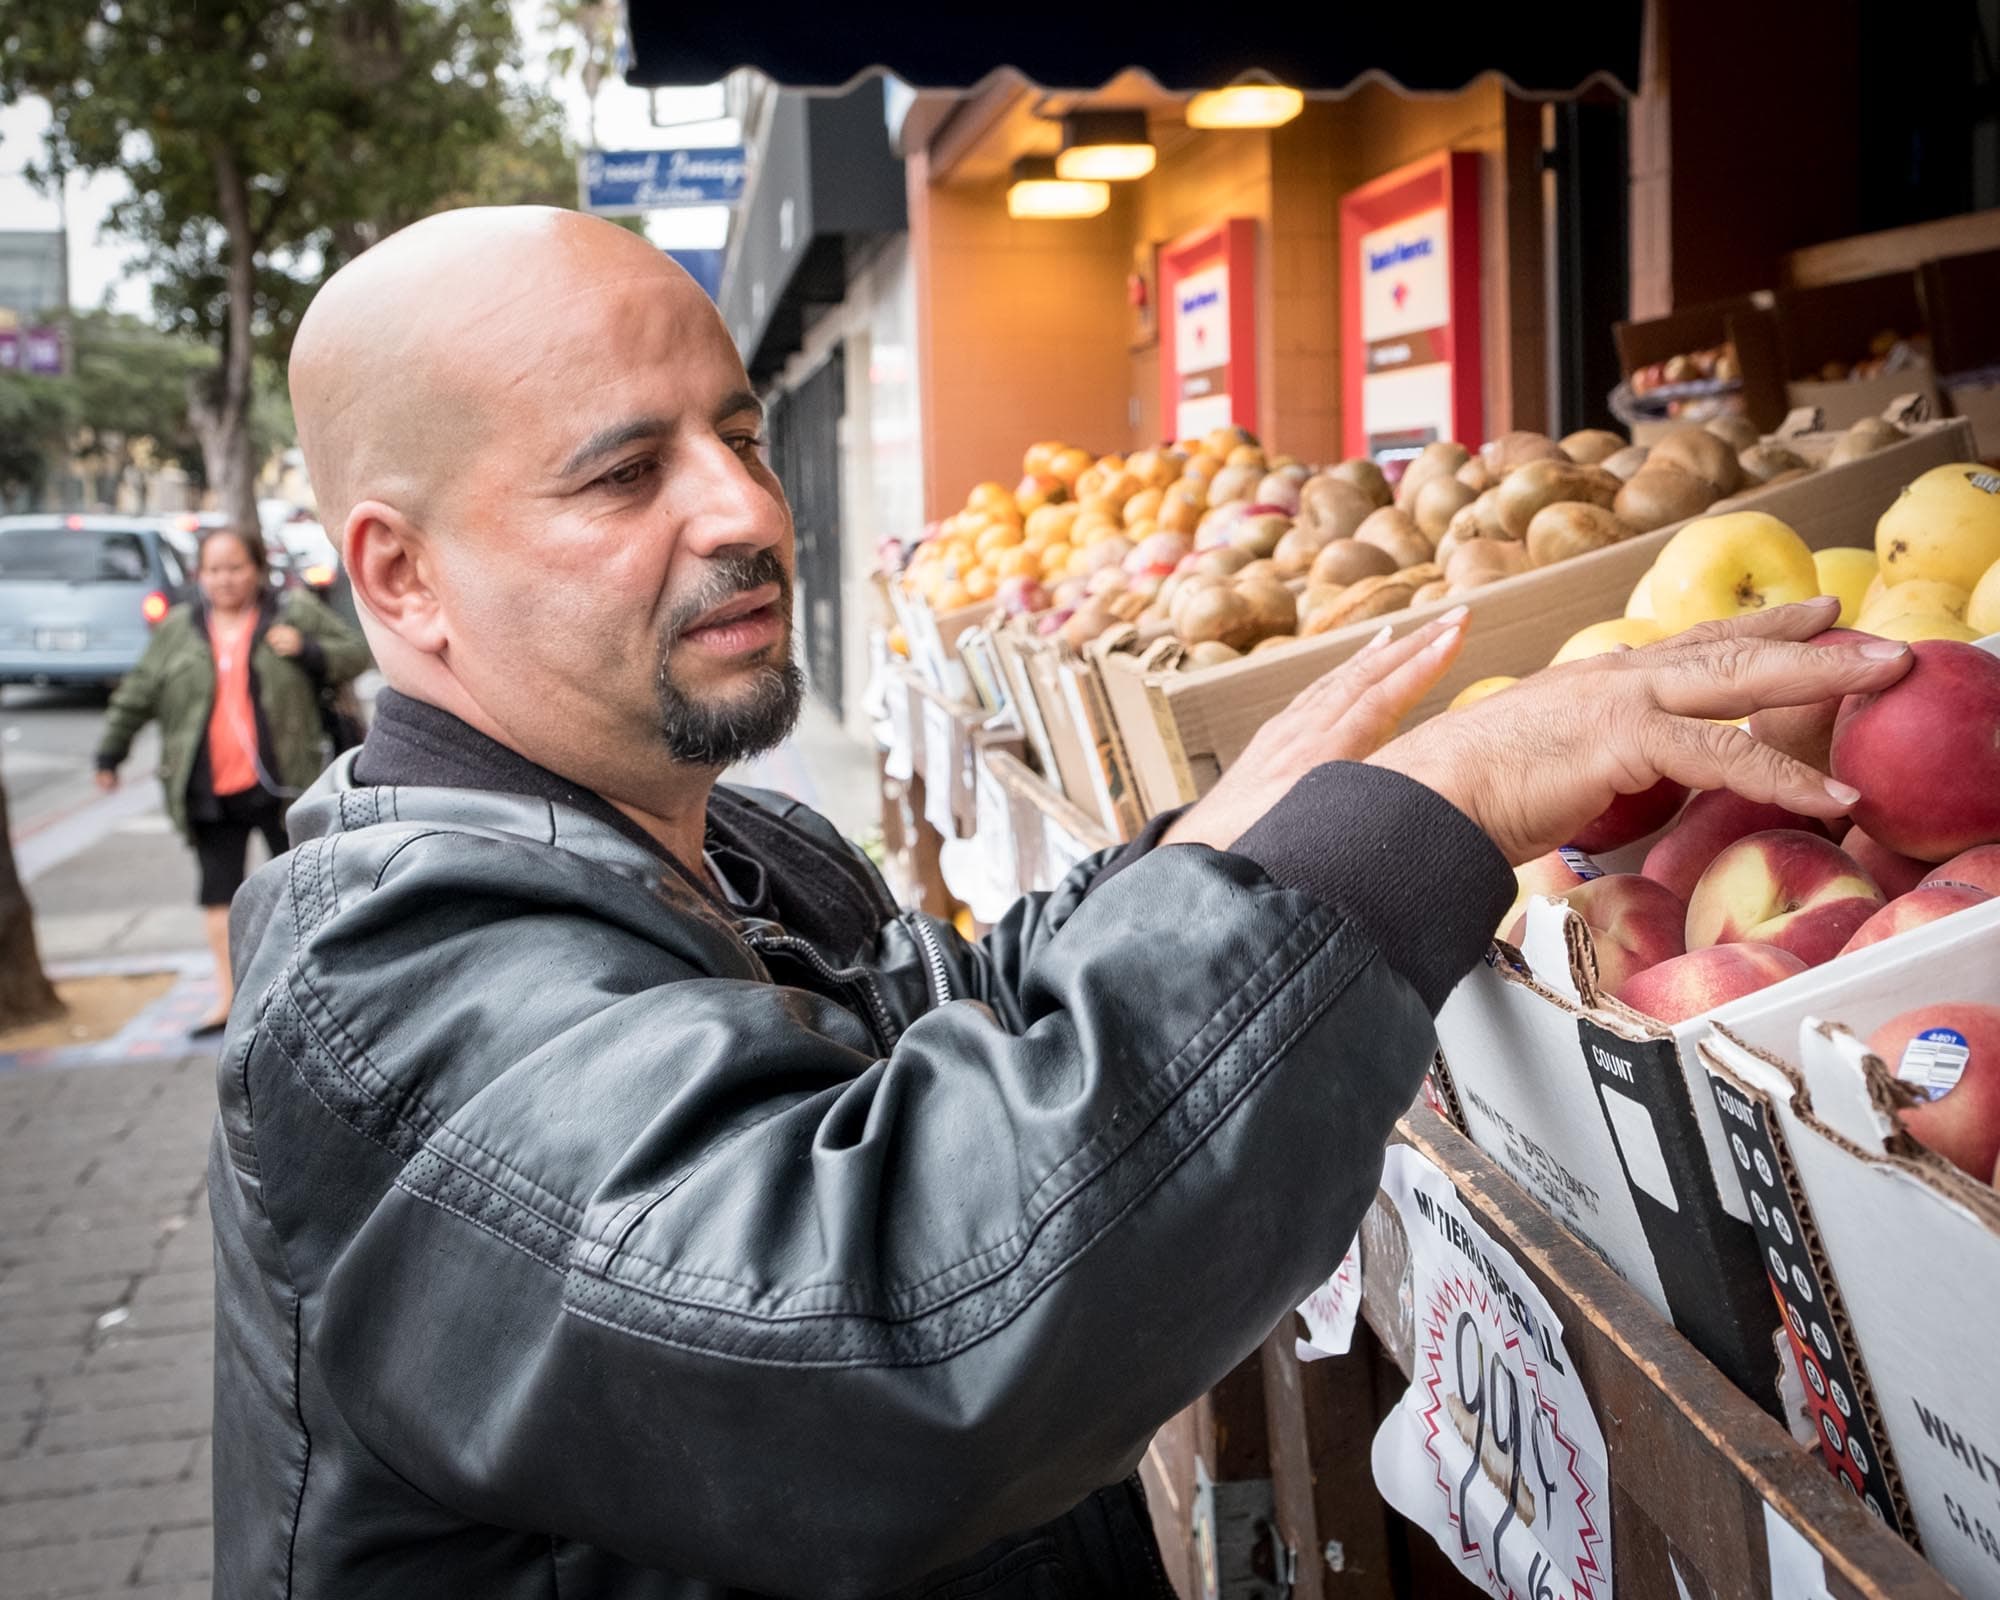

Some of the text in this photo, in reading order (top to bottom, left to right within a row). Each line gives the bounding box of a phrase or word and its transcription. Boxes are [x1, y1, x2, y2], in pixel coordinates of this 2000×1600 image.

[1592, 1044, 1634, 1084] COUNT
[1715, 1085, 1757, 1131] COUNT
[1413, 1188, 1436, 1226] MI
[1482, 1254, 1565, 1376] SPECL
